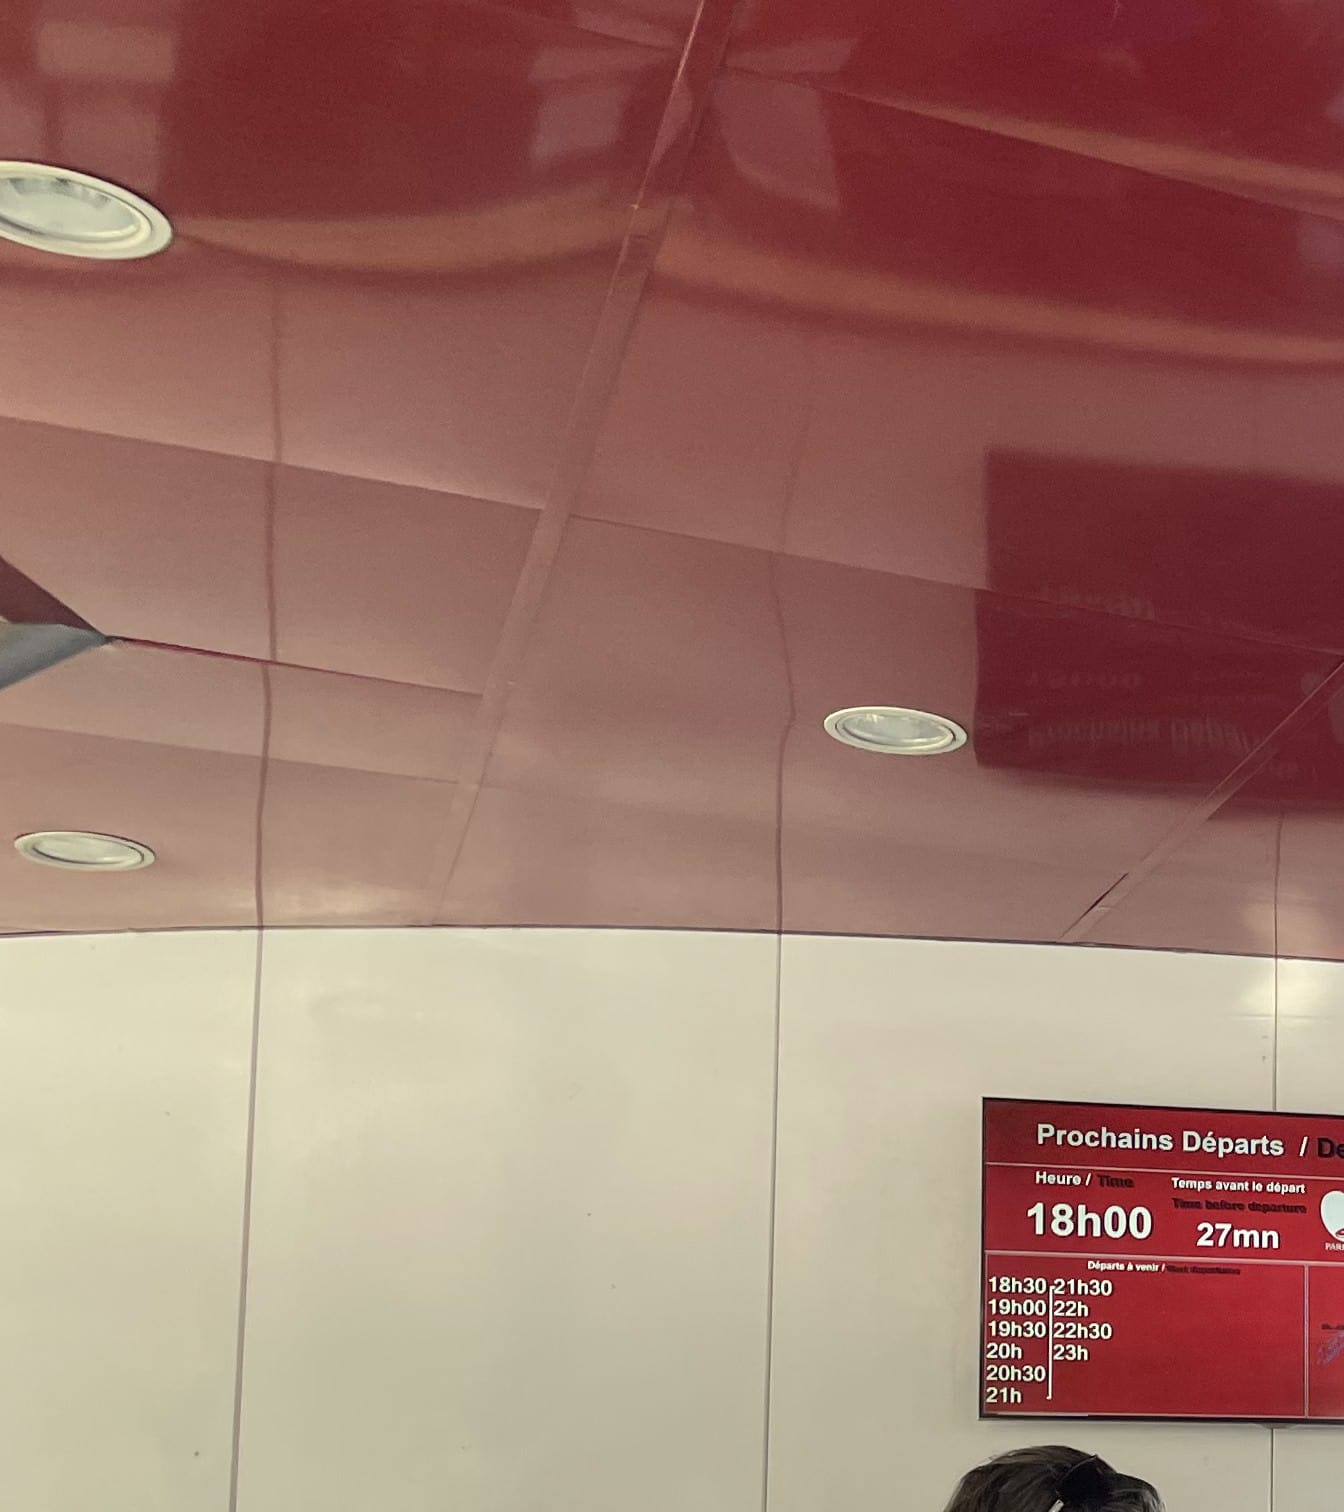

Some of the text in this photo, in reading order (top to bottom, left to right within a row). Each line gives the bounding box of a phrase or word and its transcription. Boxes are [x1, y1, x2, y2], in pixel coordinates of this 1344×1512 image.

[1037, 1123, 1174, 1150] Prochains
[1182, 1131, 1285, 1158] Départs
[1299, 1136, 1309, 1157] /
[1035, 1171, 1135, 1188] Heure / Time
[1171, 1177, 1306, 1195] Temps avant le départ
[1026, 1202, 1153, 1239] 18h00
[1196, 1222, 1280, 1249] 27mn
[1087, 1260, 1125, 1272] Départs
[988, 1276, 1047, 1294] 18h30
[1053, 1279, 1113, 1296] 21h30
[988, 1299, 1047, 1316] 19h00
[1053, 1300, 1089, 1317] 22h
[988, 1320, 1047, 1338] 19h30
[1053, 1322, 1113, 1339] 22h30
[985, 1343, 1022, 1359] 20h
[1053, 1344, 1089, 1361] 23h
[985, 1365, 1046, 1382] 20h30
[985, 1387, 1022, 1403] 21h
